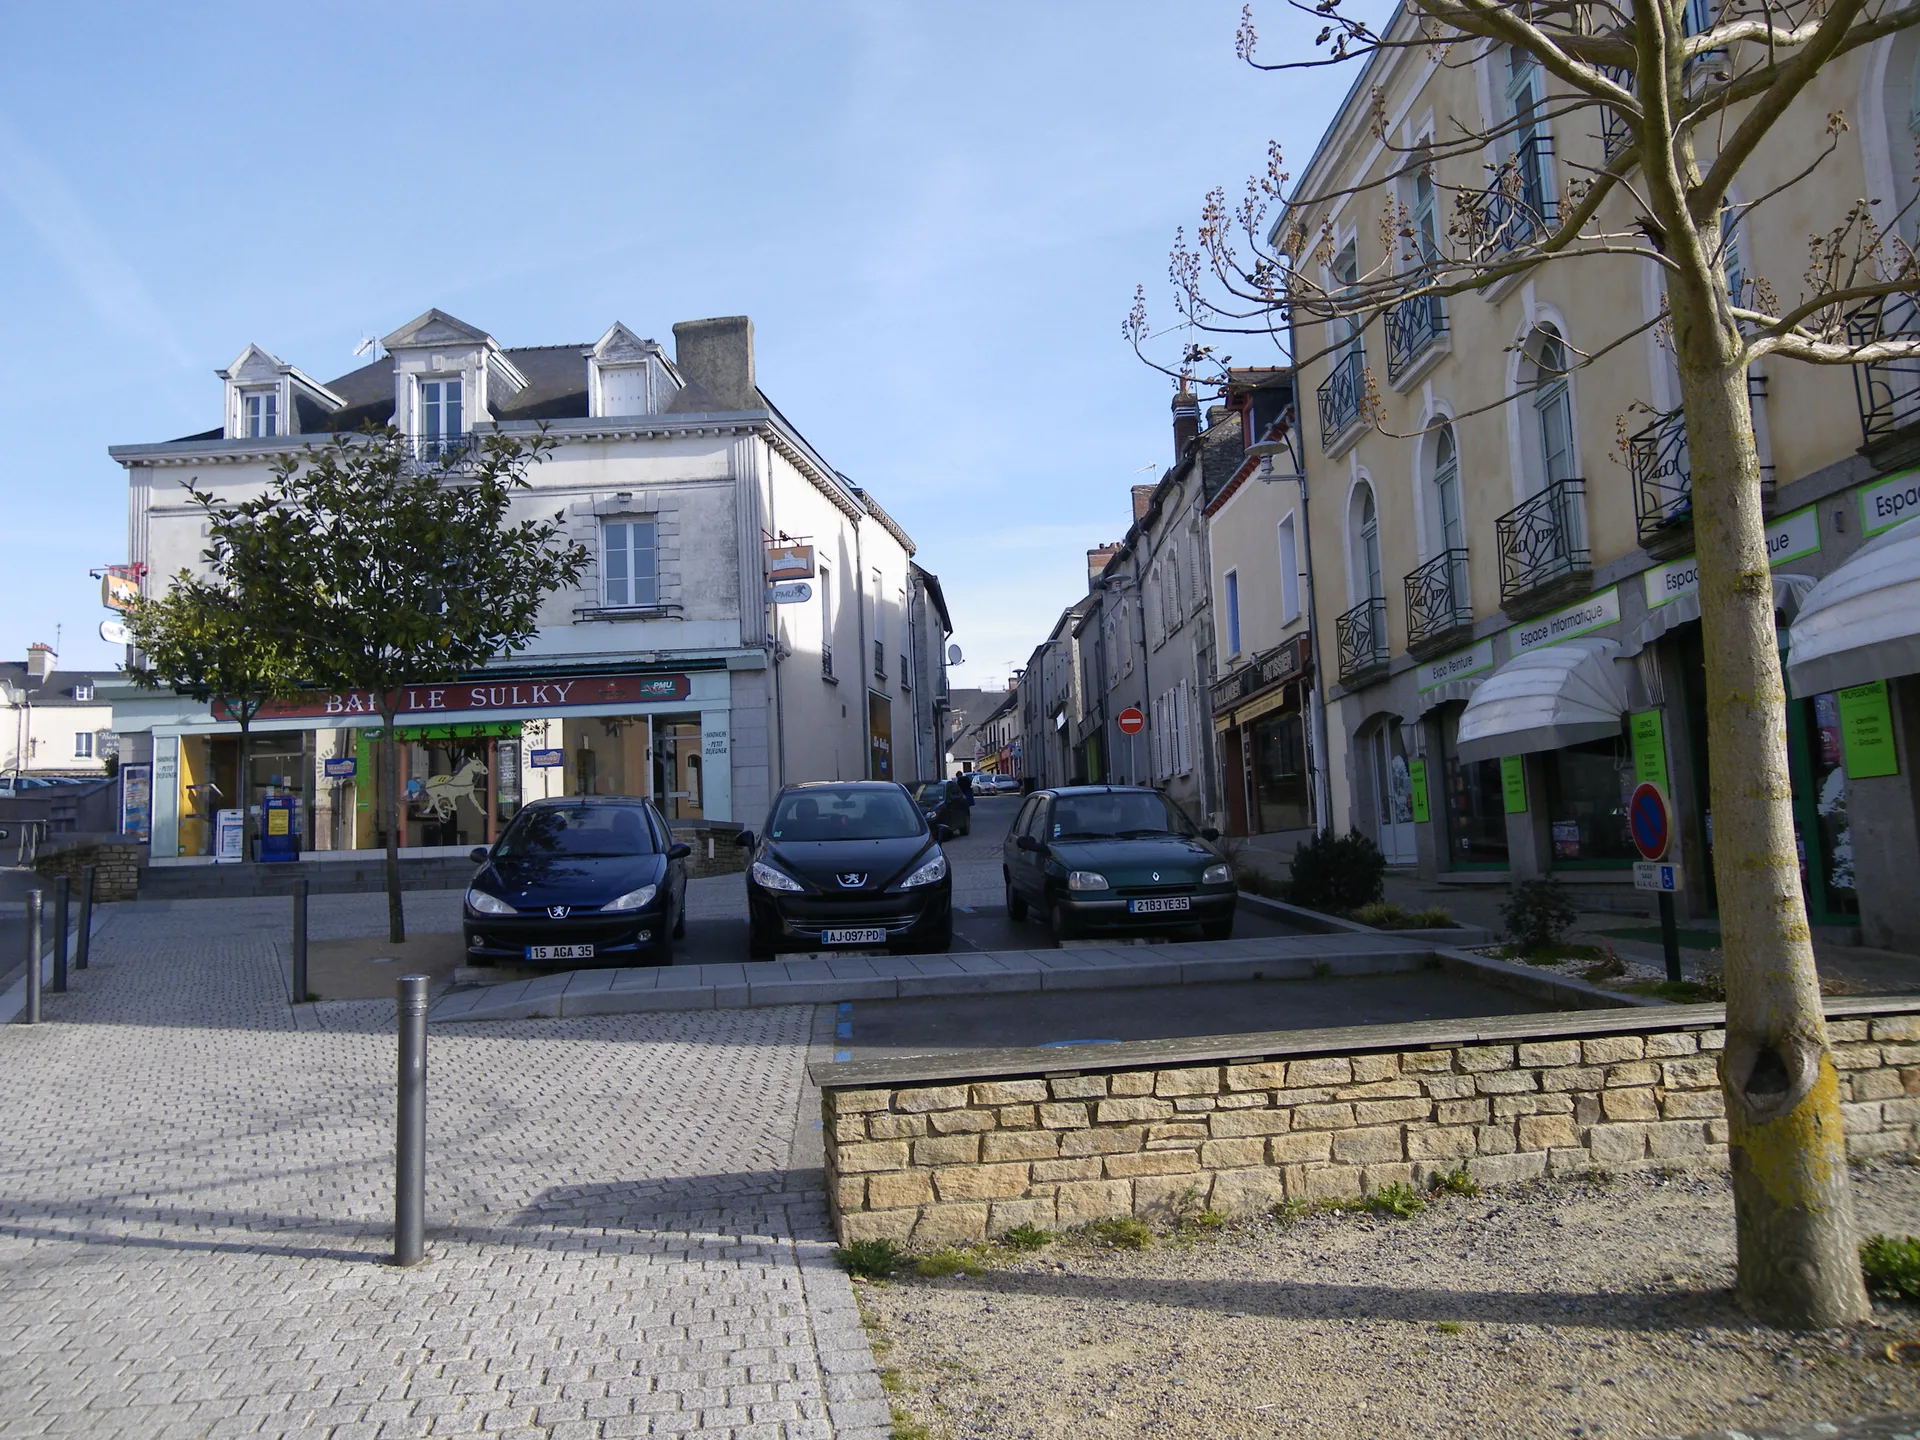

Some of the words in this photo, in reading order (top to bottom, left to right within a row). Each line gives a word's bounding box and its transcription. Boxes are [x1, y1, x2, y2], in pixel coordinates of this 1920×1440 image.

[1875, 486, 1920, 517] Espa
[774, 591, 795, 599] PMU
[1520, 624, 1548, 647] Espace
[1550, 605, 1603, 638] Informatique
[1432, 664, 1447, 680] Expo
[1449, 655, 1473, 673] Peinture
[653, 681, 673, 689] PMU
[408, 690, 447, 710] LE
[470, 681, 575, 707] SULKY
[1137, 900, 1162, 912] 2183
[1163, 899, 1175, 910] YE
[1174, 898, 1188, 909] 35
[533, 947, 547, 958] 15
[553, 947, 574, 957] AGA
[577, 945, 592, 957] 35
